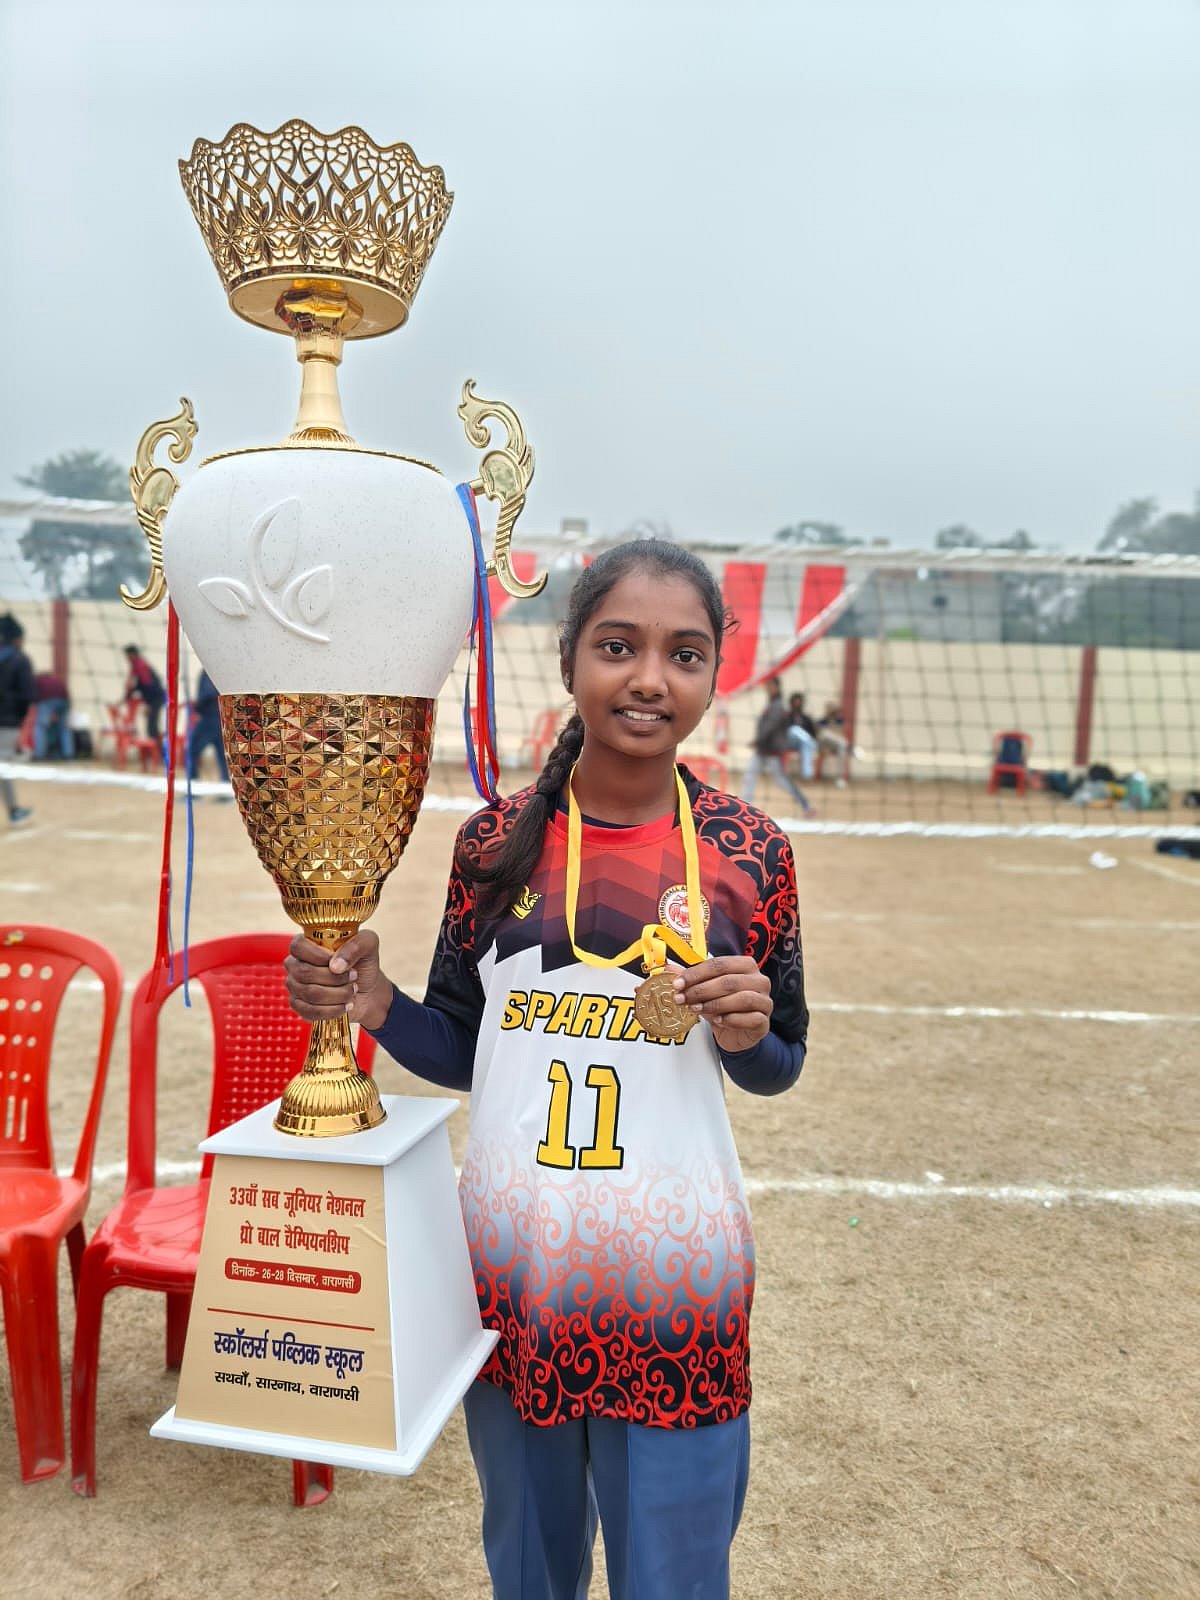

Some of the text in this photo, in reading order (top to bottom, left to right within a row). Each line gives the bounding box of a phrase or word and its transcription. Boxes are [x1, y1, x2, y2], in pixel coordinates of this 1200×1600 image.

[536, 1059, 625, 1171] 11
[262, 1190, 281, 1209] सब
[283, 1187, 323, 1218] जूनियर
[326, 1190, 366, 1218] नेशनल
[257, 1227, 281, 1247] बाल
[284, 1224, 351, 1255] चैम्पियनशिप
[262, 1268, 284, 1281] 26-28
[287, 1267, 319, 1287] दिसम्बर,
[321, 1274, 355, 1289] वाराणसी
[214, 1327, 365, 1380] स्कॉलर्स पब्लिक स्कूल
[256, 1376, 305, 1396] सारनाथ,
[309, 1384, 360, 1402] वाराणसी
